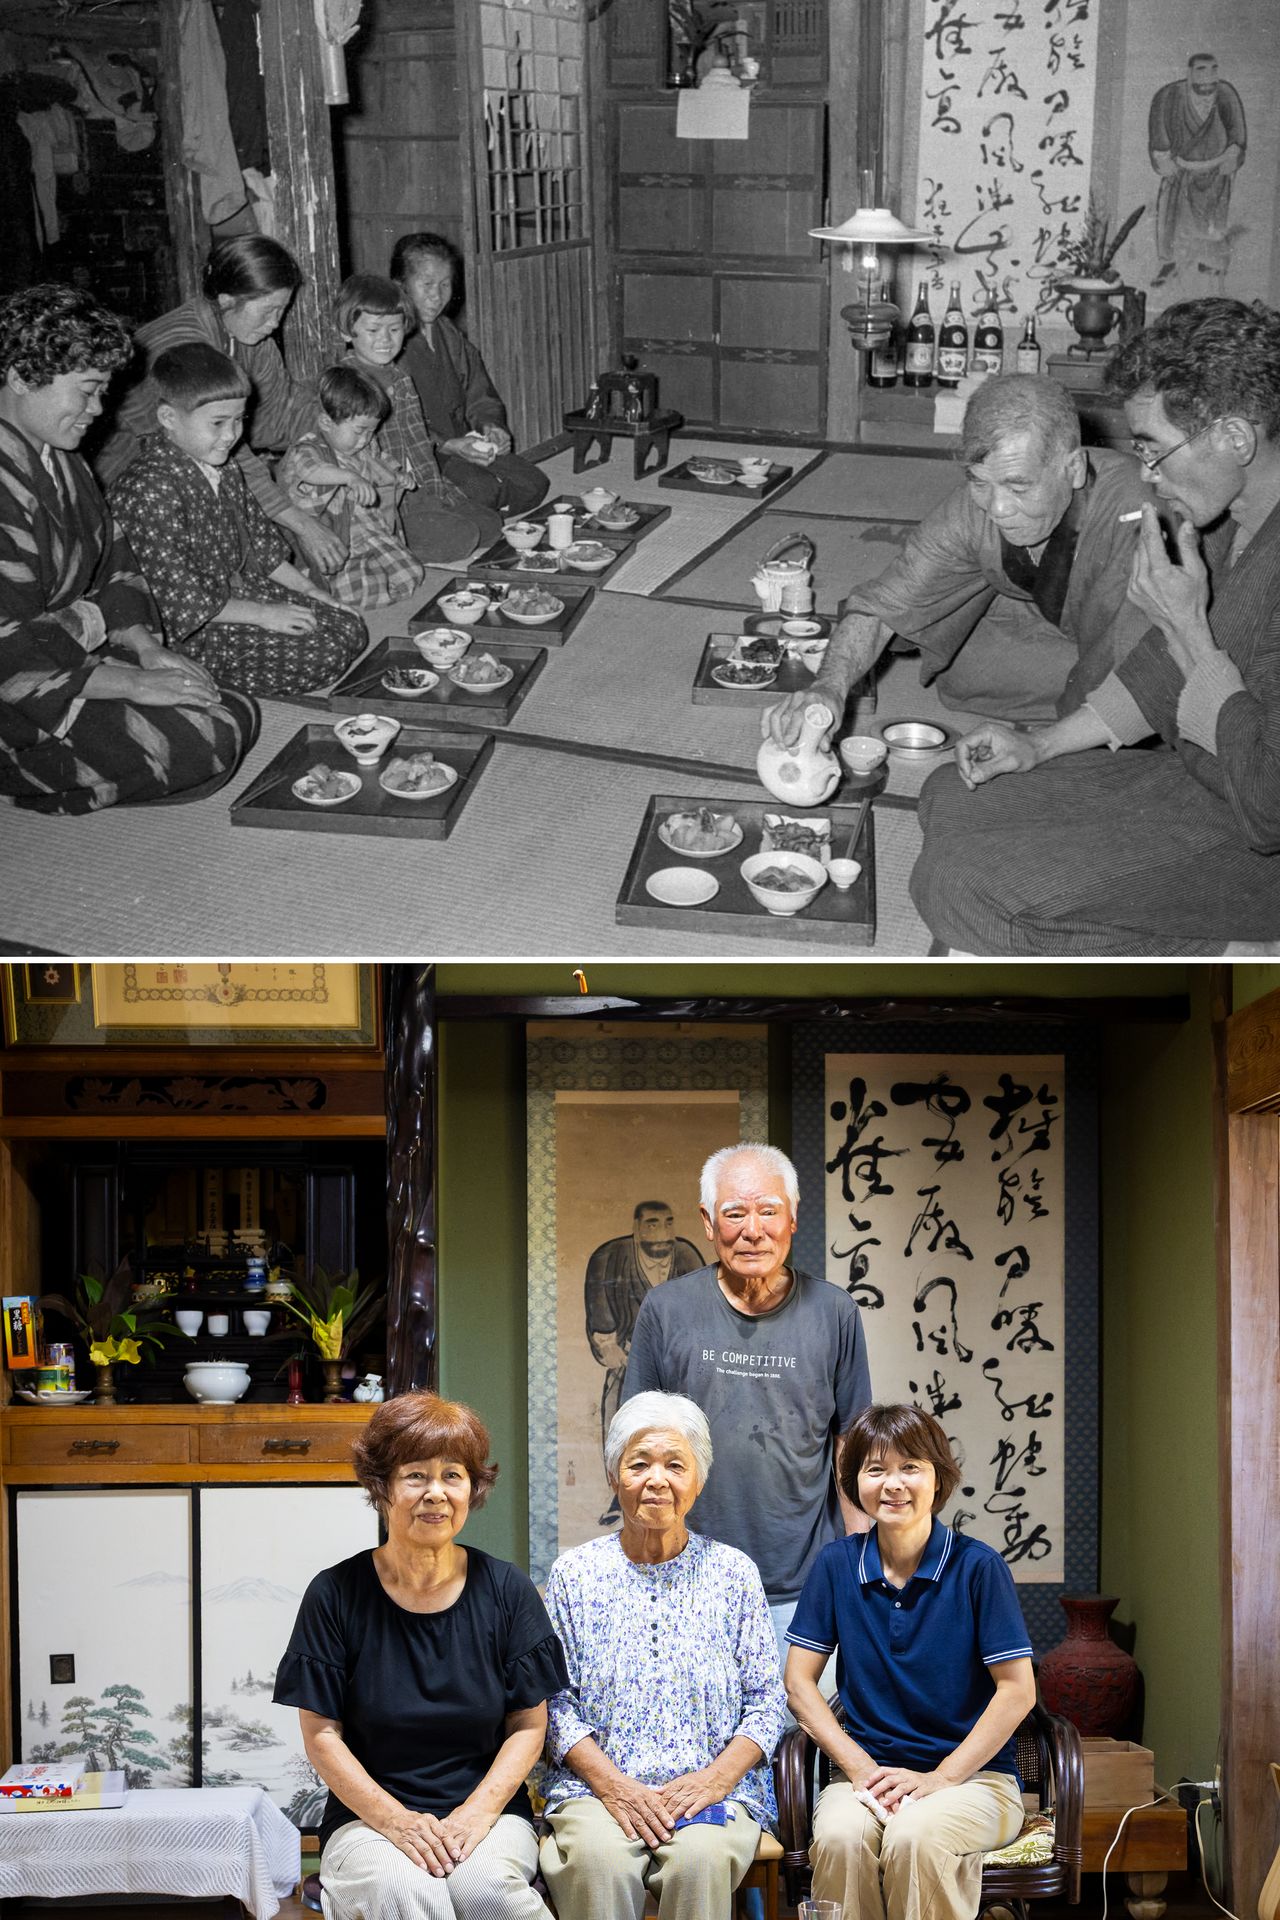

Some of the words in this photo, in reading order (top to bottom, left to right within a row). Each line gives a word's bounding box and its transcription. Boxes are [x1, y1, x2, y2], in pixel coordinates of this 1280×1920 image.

[702, 1349, 715, 1361] BE
[722, 1351, 796, 1368] COMPETITIVE
[726, 1368, 748, 1378] challenge
